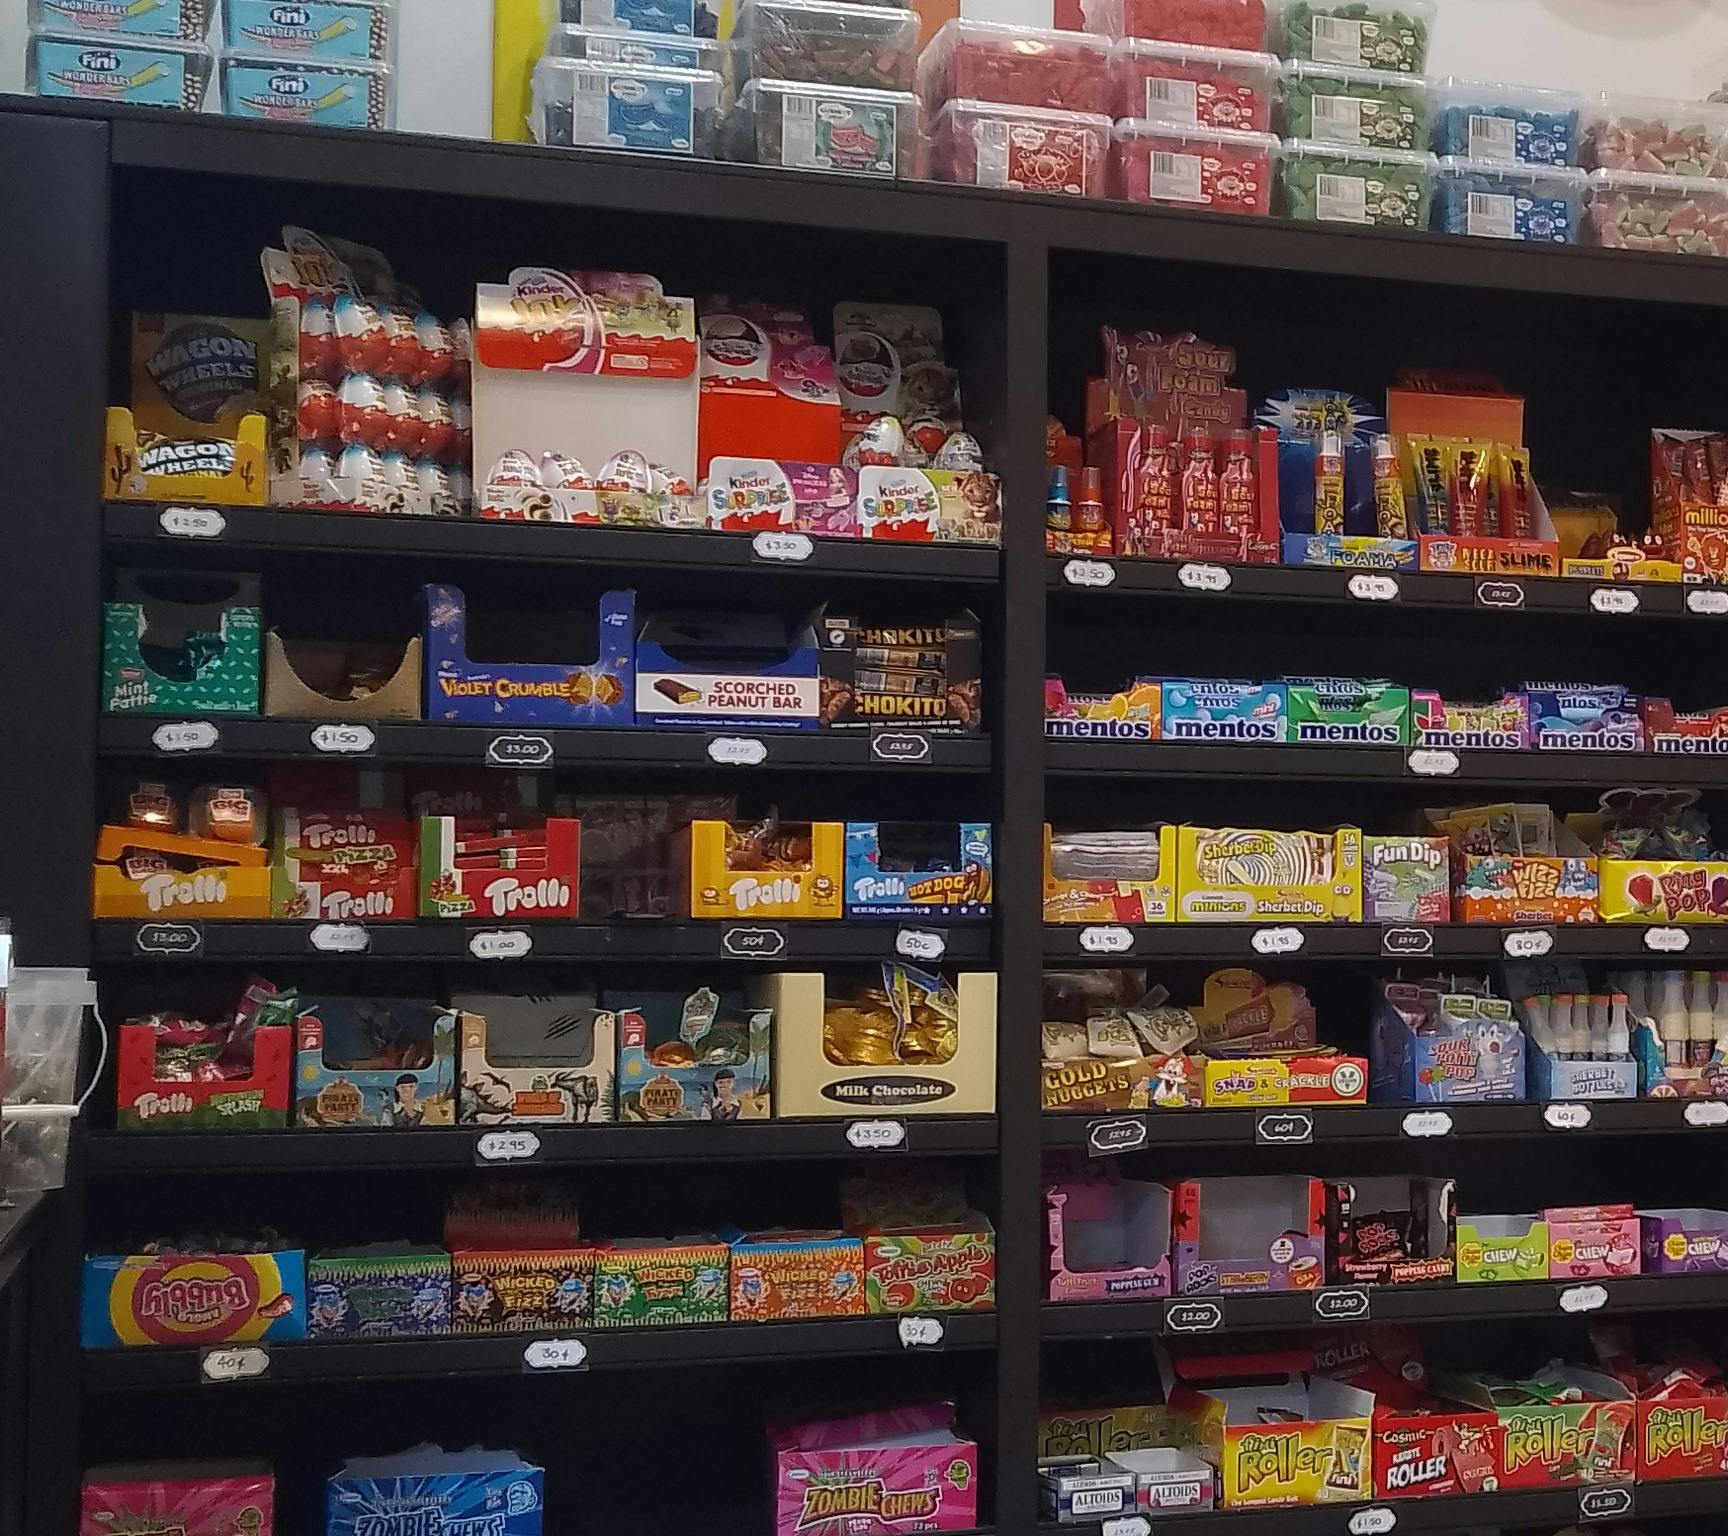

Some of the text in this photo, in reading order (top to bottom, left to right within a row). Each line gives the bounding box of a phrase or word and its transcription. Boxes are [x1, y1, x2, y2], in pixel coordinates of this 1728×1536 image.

[273, 9, 307, 25] Fini
[81, 53, 117, 69] Fini
[271, 77, 305, 94] Fini
[517, 283, 565, 296] Kinder
[149, 337, 256, 373] WAGON
[158, 363, 254, 388] WHEELS
[1158, 366, 1220, 395] Foam
[140, 444, 236, 468] WAGON
[149, 456, 236, 476] WHEELS
[713, 488, 788, 510] SURPRISE
[862, 495, 937, 515] SURPRISE
[1331, 550, 1397, 568] FOAMA
[1500, 552, 1552, 568] SLIME
[114, 681, 150, 696] Mint
[443, 678, 570, 698] VIOLET CRUMBLE
[713, 681, 797, 696] SCORCHED
[109, 692, 157, 711] Pattie
[708, 694, 803, 709] PEANUT BAR
[1046, 719, 1150, 739] mentos
[1174, 721, 1276, 740] mentos
[1300, 723, 1398, 743] mentos
[1423, 730, 1521, 749] mentos
[1540, 730, 1635, 750] mentos
[213, 799, 249, 812] BIG
[304, 825, 375, 848] Trolli
[335, 846, 395, 863] PIZZA
[1204, 840, 1278, 860] Sherbet Dip
[1373, 842, 1442, 868] Fun Dip
[321, 863, 348, 874] XXL
[1512, 862, 1561, 884] WIZZ
[854, 875, 904, 902] Trolli
[908, 874, 966, 899] HOT DOG
[1516, 881, 1556, 900] FIZZ
[1658, 869, 1707, 896] Ring
[141, 876, 226, 911] Trolli
[485, 878, 569, 915] Trolli
[730, 877, 800, 911] Trolli
[323, 890, 393, 919] Trolli
[440, 901, 475, 914] PIZZA
[1189, 900, 1246, 913] minions
[1257, 900, 1325, 917] Sherbet Dip
[1663, 892, 1711, 920] POP
[1514, 910, 1554, 923] sherbet
[1430, 1039, 1471, 1056] SOUR
[1044, 1062, 1107, 1091] GOLD
[1274, 1073, 1330, 1089] CRACKLE
[1444, 1066, 1476, 1081] POP
[644, 1087, 680, 1099] PIRATE
[835, 1083, 943, 1098] Milk Chocolate
[1045, 1074, 1130, 1107] NUGGETS
[135, 1094, 193, 1119] Trolli
[215, 1098, 262, 1115] SPLASH
[646, 1097, 678, 1107] PARTY
[1483, 1247, 1516, 1263] CHEW
[1575, 1245, 1608, 1261] CHEW
[1688, 1241, 1720, 1257] CHEW
[872, 1246, 989, 1284] Toffee Apple
[1187, 1265, 1216, 1281] POP
[1345, 1263, 1388, 1274] Strawberry
[494, 1276, 556, 1291] WICKED
[636, 1269, 695, 1283] WICKED
[772, 1270, 829, 1284] WICKED
[1185, 1275, 1217, 1293] ROCKS
[1505, 1415, 1594, 1472] Roller
[1238, 1432, 1333, 1492] Roller
[1386, 1456, 1447, 1490] ROLLER
[803, 1482, 938, 1520] ZOMBIE CHEWS
[1075, 1490, 1121, 1506] ALTOIDS
[1152, 1485, 1199, 1499] ALTOIDS
